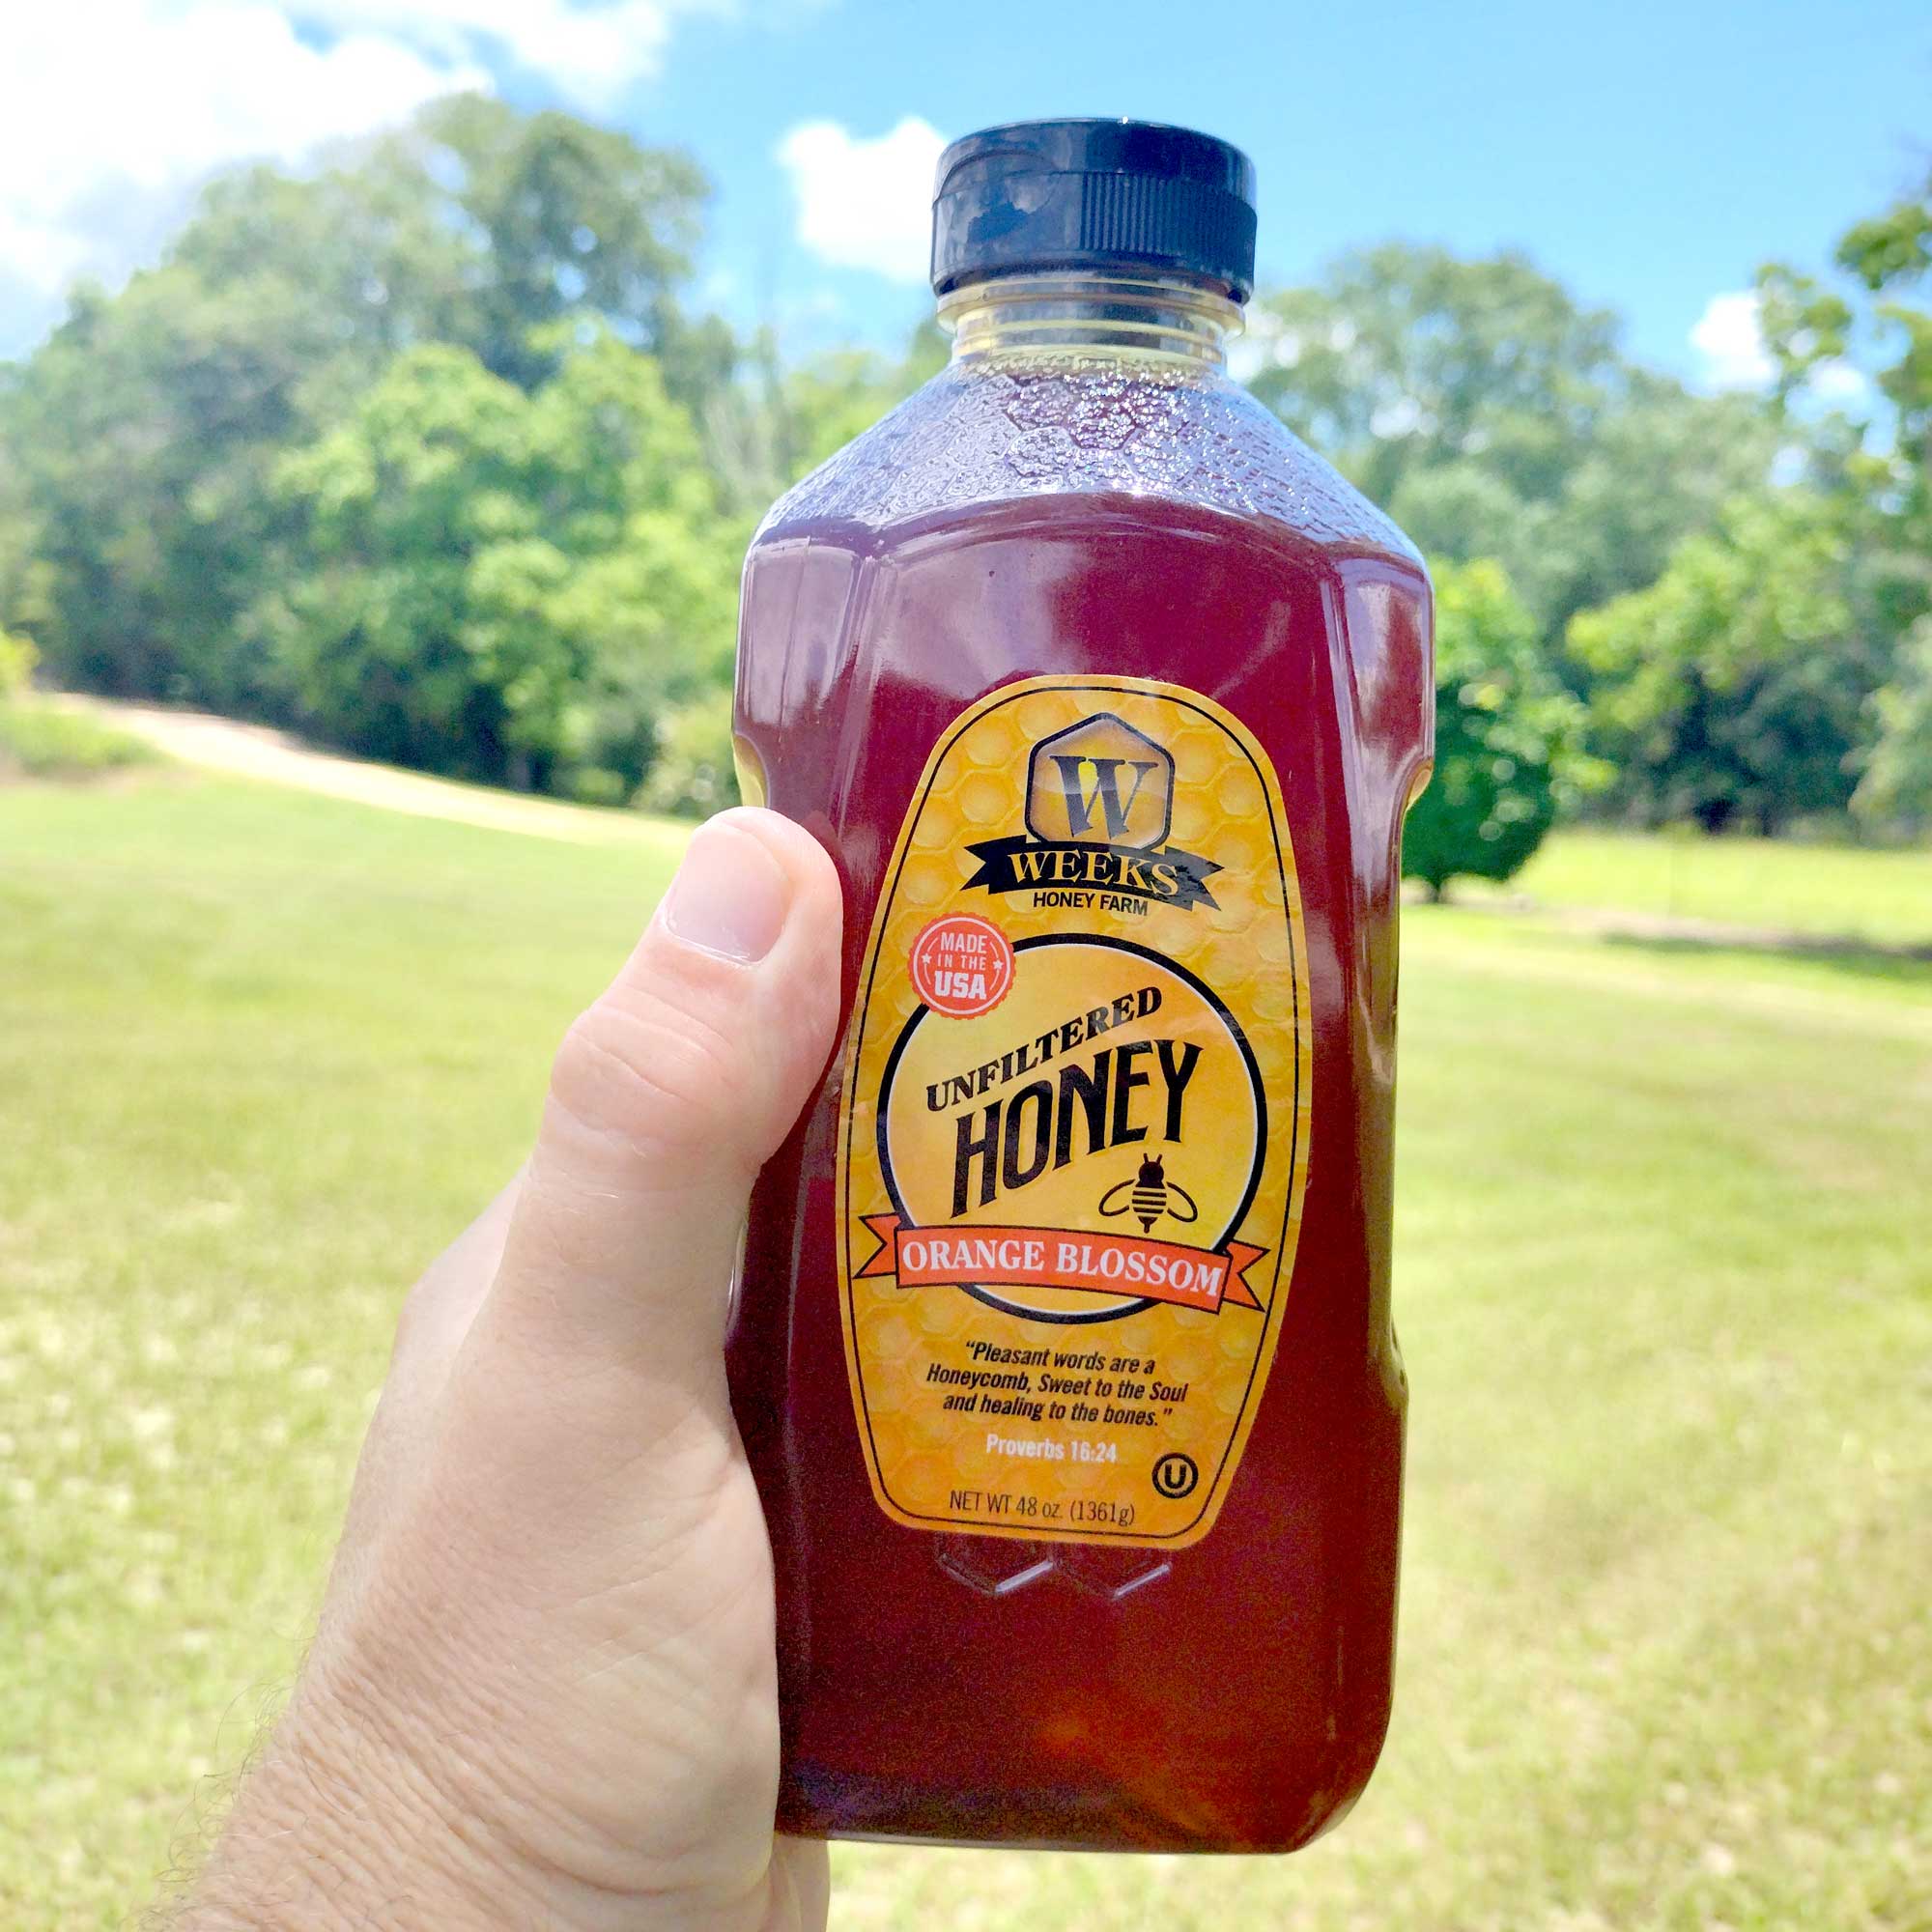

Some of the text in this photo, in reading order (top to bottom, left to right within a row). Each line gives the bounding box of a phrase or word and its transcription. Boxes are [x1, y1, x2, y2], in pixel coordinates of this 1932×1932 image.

[1008, 850, 1178, 896] WEEKS
[1033, 892, 1149, 917] HONEY FARM
[940, 931, 986, 954] MADE
[937, 955, 986, 971] IN THE
[934, 970, 986, 1001] USA
[925, 985, 1162, 1112] UNFILTERED
[950, 1038, 1205, 1219] HONEY
[902, 1239, 1224, 1296] ORANGE BLOSSOM
[1054, 1348, 1106, 1372] words
[1110, 1358, 1139, 1374] are
[1143, 1359, 1155, 1374] a
[926, 1364, 1188, 1403] Honeycomb, Sweet to the Soul
[943, 1393, 977, 1412] and
[980, 1394, 1043, 1421] healing
[1049, 1402, 1065, 1420] to
[1071, 1403, 1098, 1422] the
[986, 1434, 1117, 1463] Proverbs 16:24
[950, 1491, 984, 1512] NET
[987, 1493, 1012, 1514] WT
[1016, 1496, 1037, 1517] 48
[1069, 1499, 1135, 1526] (1361g)
